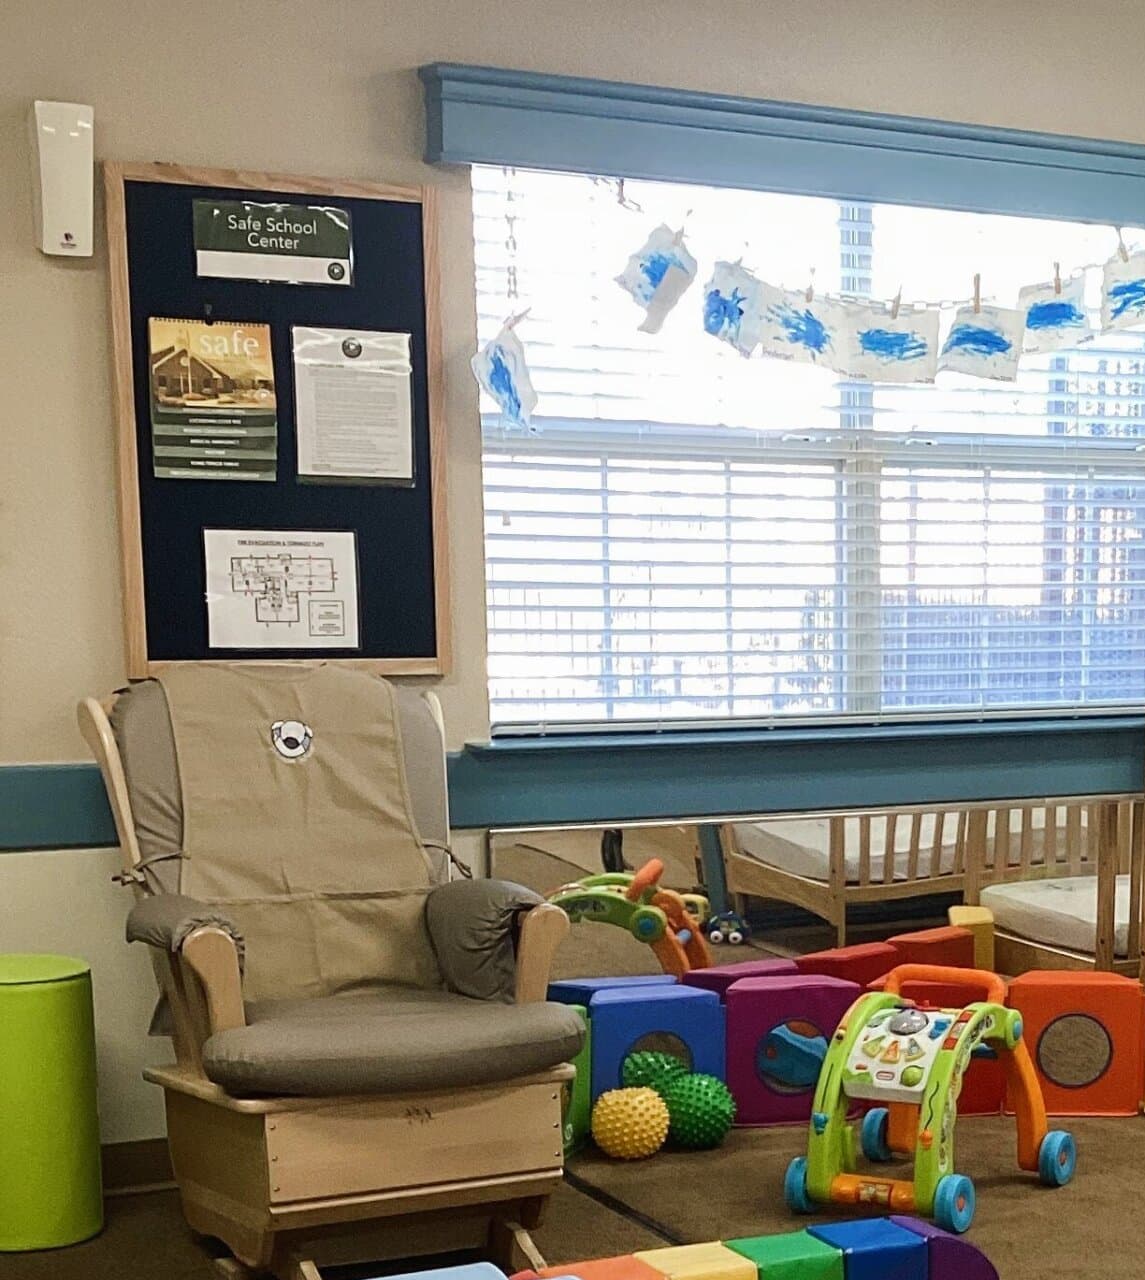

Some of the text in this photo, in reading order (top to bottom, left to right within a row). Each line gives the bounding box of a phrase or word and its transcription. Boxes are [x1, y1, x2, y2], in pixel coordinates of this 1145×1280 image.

[227, 214, 317, 235] Safe School
[247, 232, 300, 249] Center
[200, 329, 259, 356] safe
